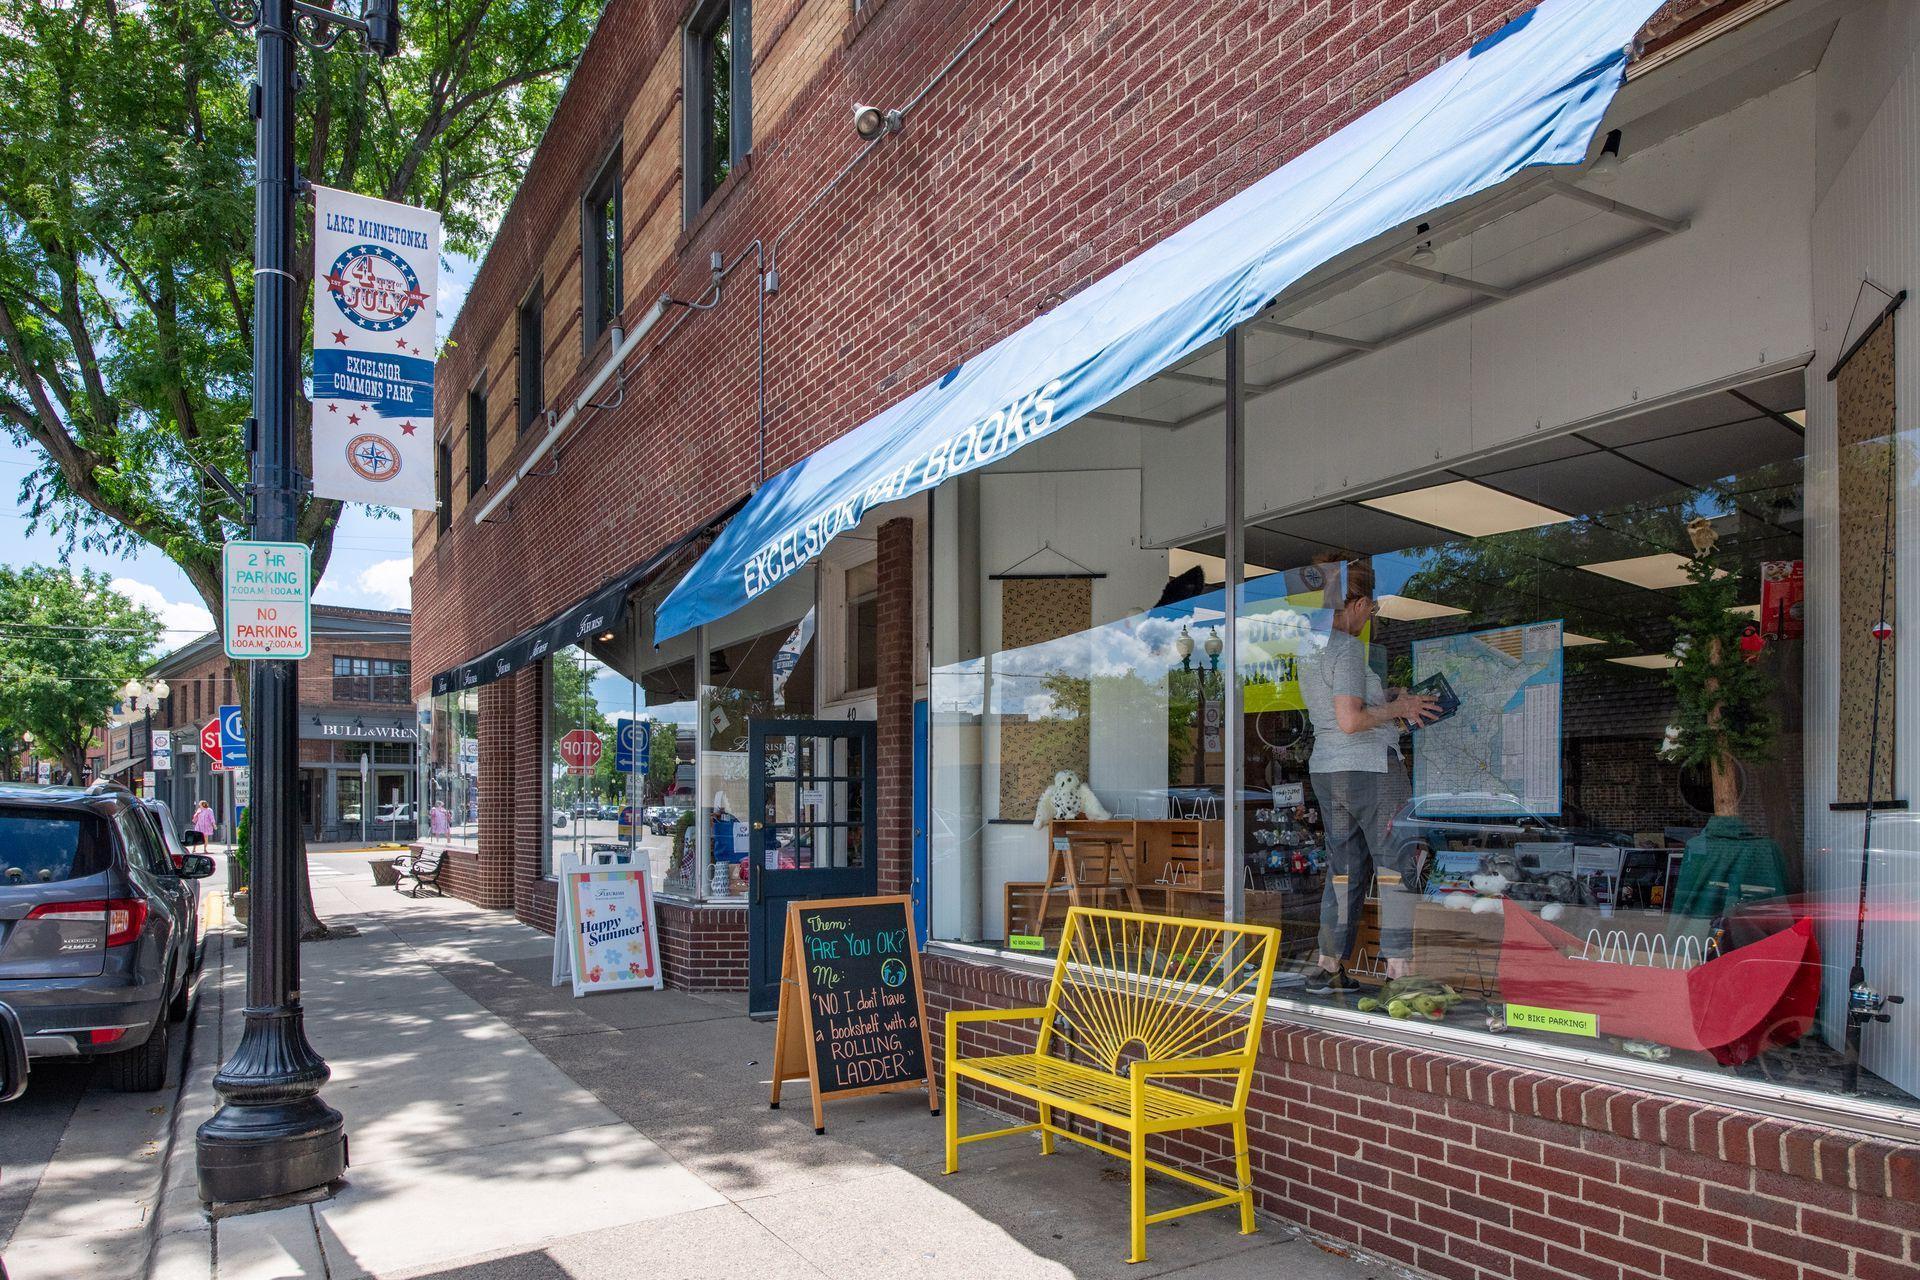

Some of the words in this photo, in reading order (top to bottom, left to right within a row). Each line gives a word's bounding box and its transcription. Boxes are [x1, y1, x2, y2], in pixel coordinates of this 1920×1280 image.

[327, 213, 354, 235] LAKE
[358, 219, 428, 250] MINNETONKA
[344, 286, 408, 316] JULY
[346, 356, 401, 380] EXCELSIOR
[334, 373, 383, 399] COMMONS
[386, 383, 414, 403] PARK
[744, 496, 860, 599] EXCELSIOR
[922, 379, 1062, 486] BOOKS
[248, 554, 258, 566] 2
[266, 554, 286, 567] HR
[236, 571, 298, 584] PARKING
[257, 607, 277, 621] NO
[237, 625, 298, 638] PARKING
[847, 707, 857, 721] 40
[204, 732, 222, 748] ST
[580, 918, 621, 934] Happy
[588, 921, 645, 947] Summer!
[807, 915, 851, 932] Them:
[843, 933, 871, 957] YOU
[813, 965, 845, 989] Me:
[844, 990, 853, 1013] I
[881, 988, 906, 1006] have
[815, 1029, 825, 1042] a
[830, 1013, 879, 1040] bookshelf
[884, 1012, 907, 1031] with
[909, 1016, 918, 1028] a
[1513, 1012, 1525, 1021] NO
[1527, 1014, 1546, 1024] BIKE
[1548, 1016, 1588, 1029] PARKING!
[832, 1034, 902, 1060] ROLLING
